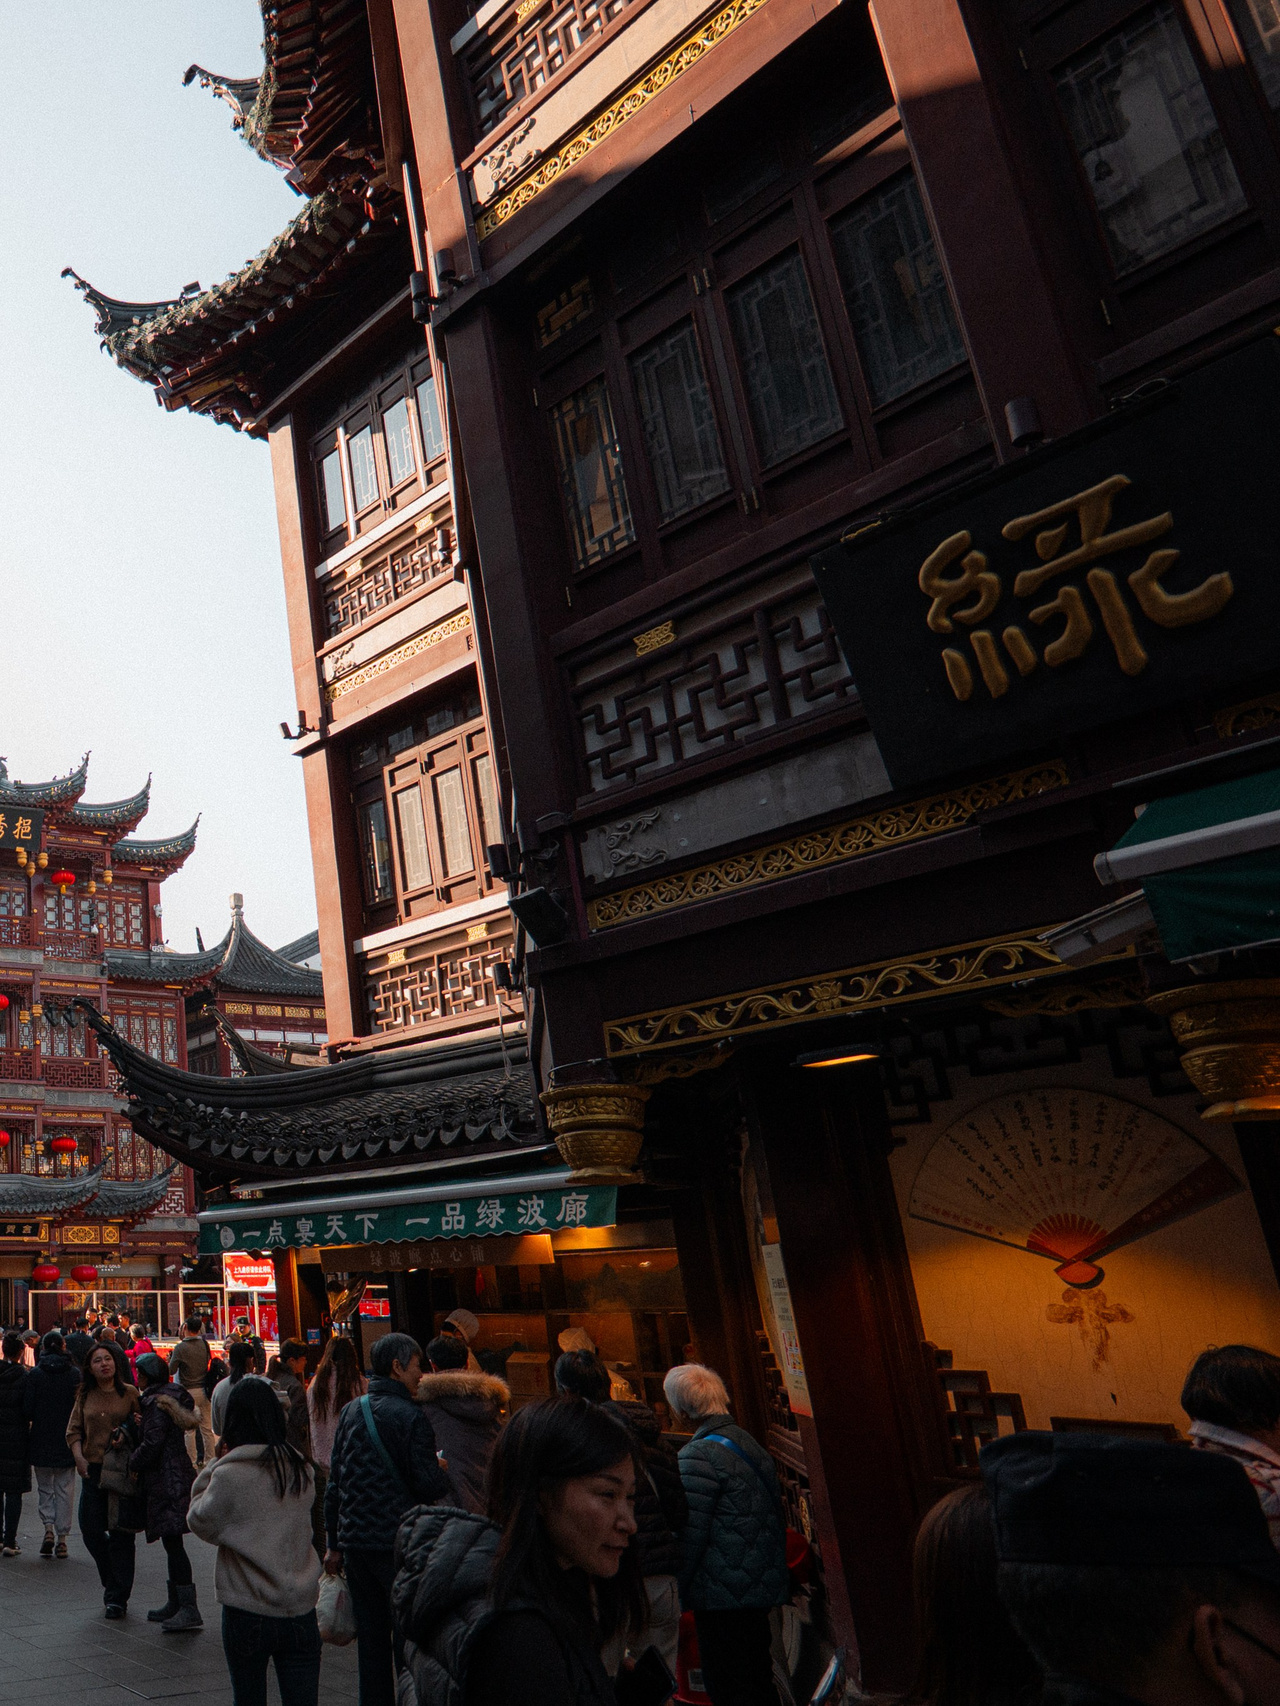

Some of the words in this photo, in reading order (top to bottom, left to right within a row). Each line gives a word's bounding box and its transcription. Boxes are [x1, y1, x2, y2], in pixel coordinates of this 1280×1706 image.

[242, 1213, 379, 1243] 一点宴天下
[405, 1192, 589, 1231] 一品绿波廊
